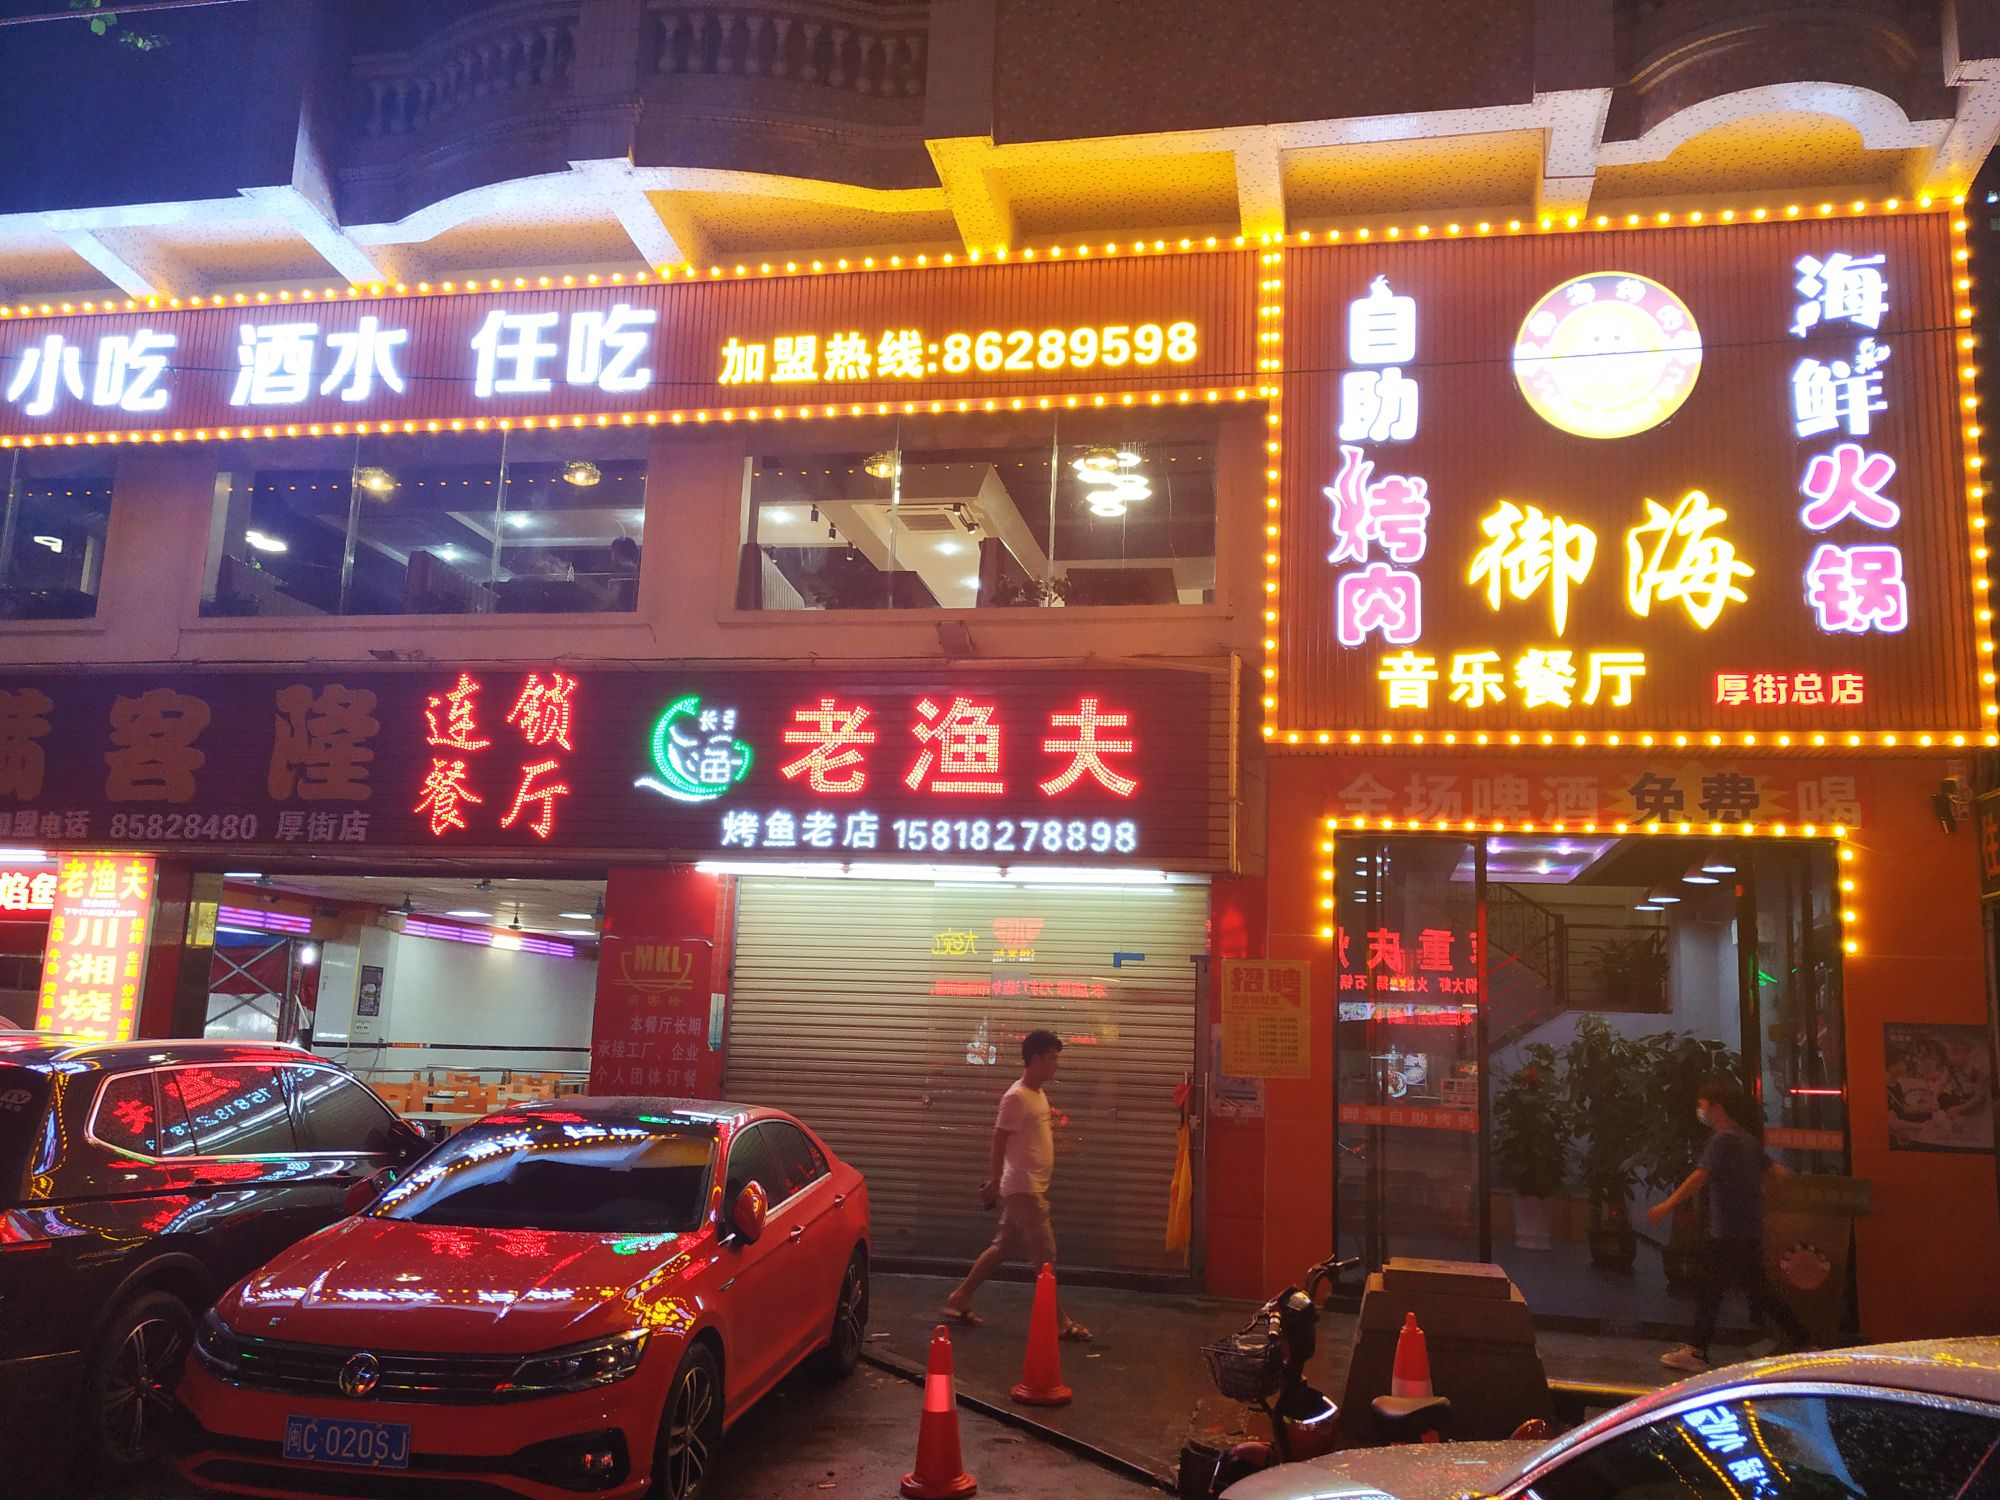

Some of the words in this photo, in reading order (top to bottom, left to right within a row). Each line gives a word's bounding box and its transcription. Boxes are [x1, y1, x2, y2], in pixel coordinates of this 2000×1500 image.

[8, 328, 177, 415] 小吃
[231, 316, 407, 406] 酒水
[471, 304, 657, 399] 任吃
[1324, 275, 1430, 646] 自助烤肉
[1791, 254, 1909, 634] 海鲜火锅
[1468, 491, 1754, 638] 御海
[1379, 650, 1647, 709] 音乐餐厅
[1716, 673, 1865, 706] 厚街总店
[781, 697, 1138, 797] 老渔夫
[110, 813, 259, 840] 85828480
[274, 810, 371, 842] 厚街店
[721, 811, 878, 848] 烤鱼老店
[893, 819, 1138, 853] 15818278898
[58, 858, 148, 900] 老渔夫
[634, 945, 682, 972] MKL
[1231, 967, 1301, 993] 招聘
[630, 1015, 702, 1036] 本餐厅长期
[595, 1066, 697, 1087] 个人团体订餐
